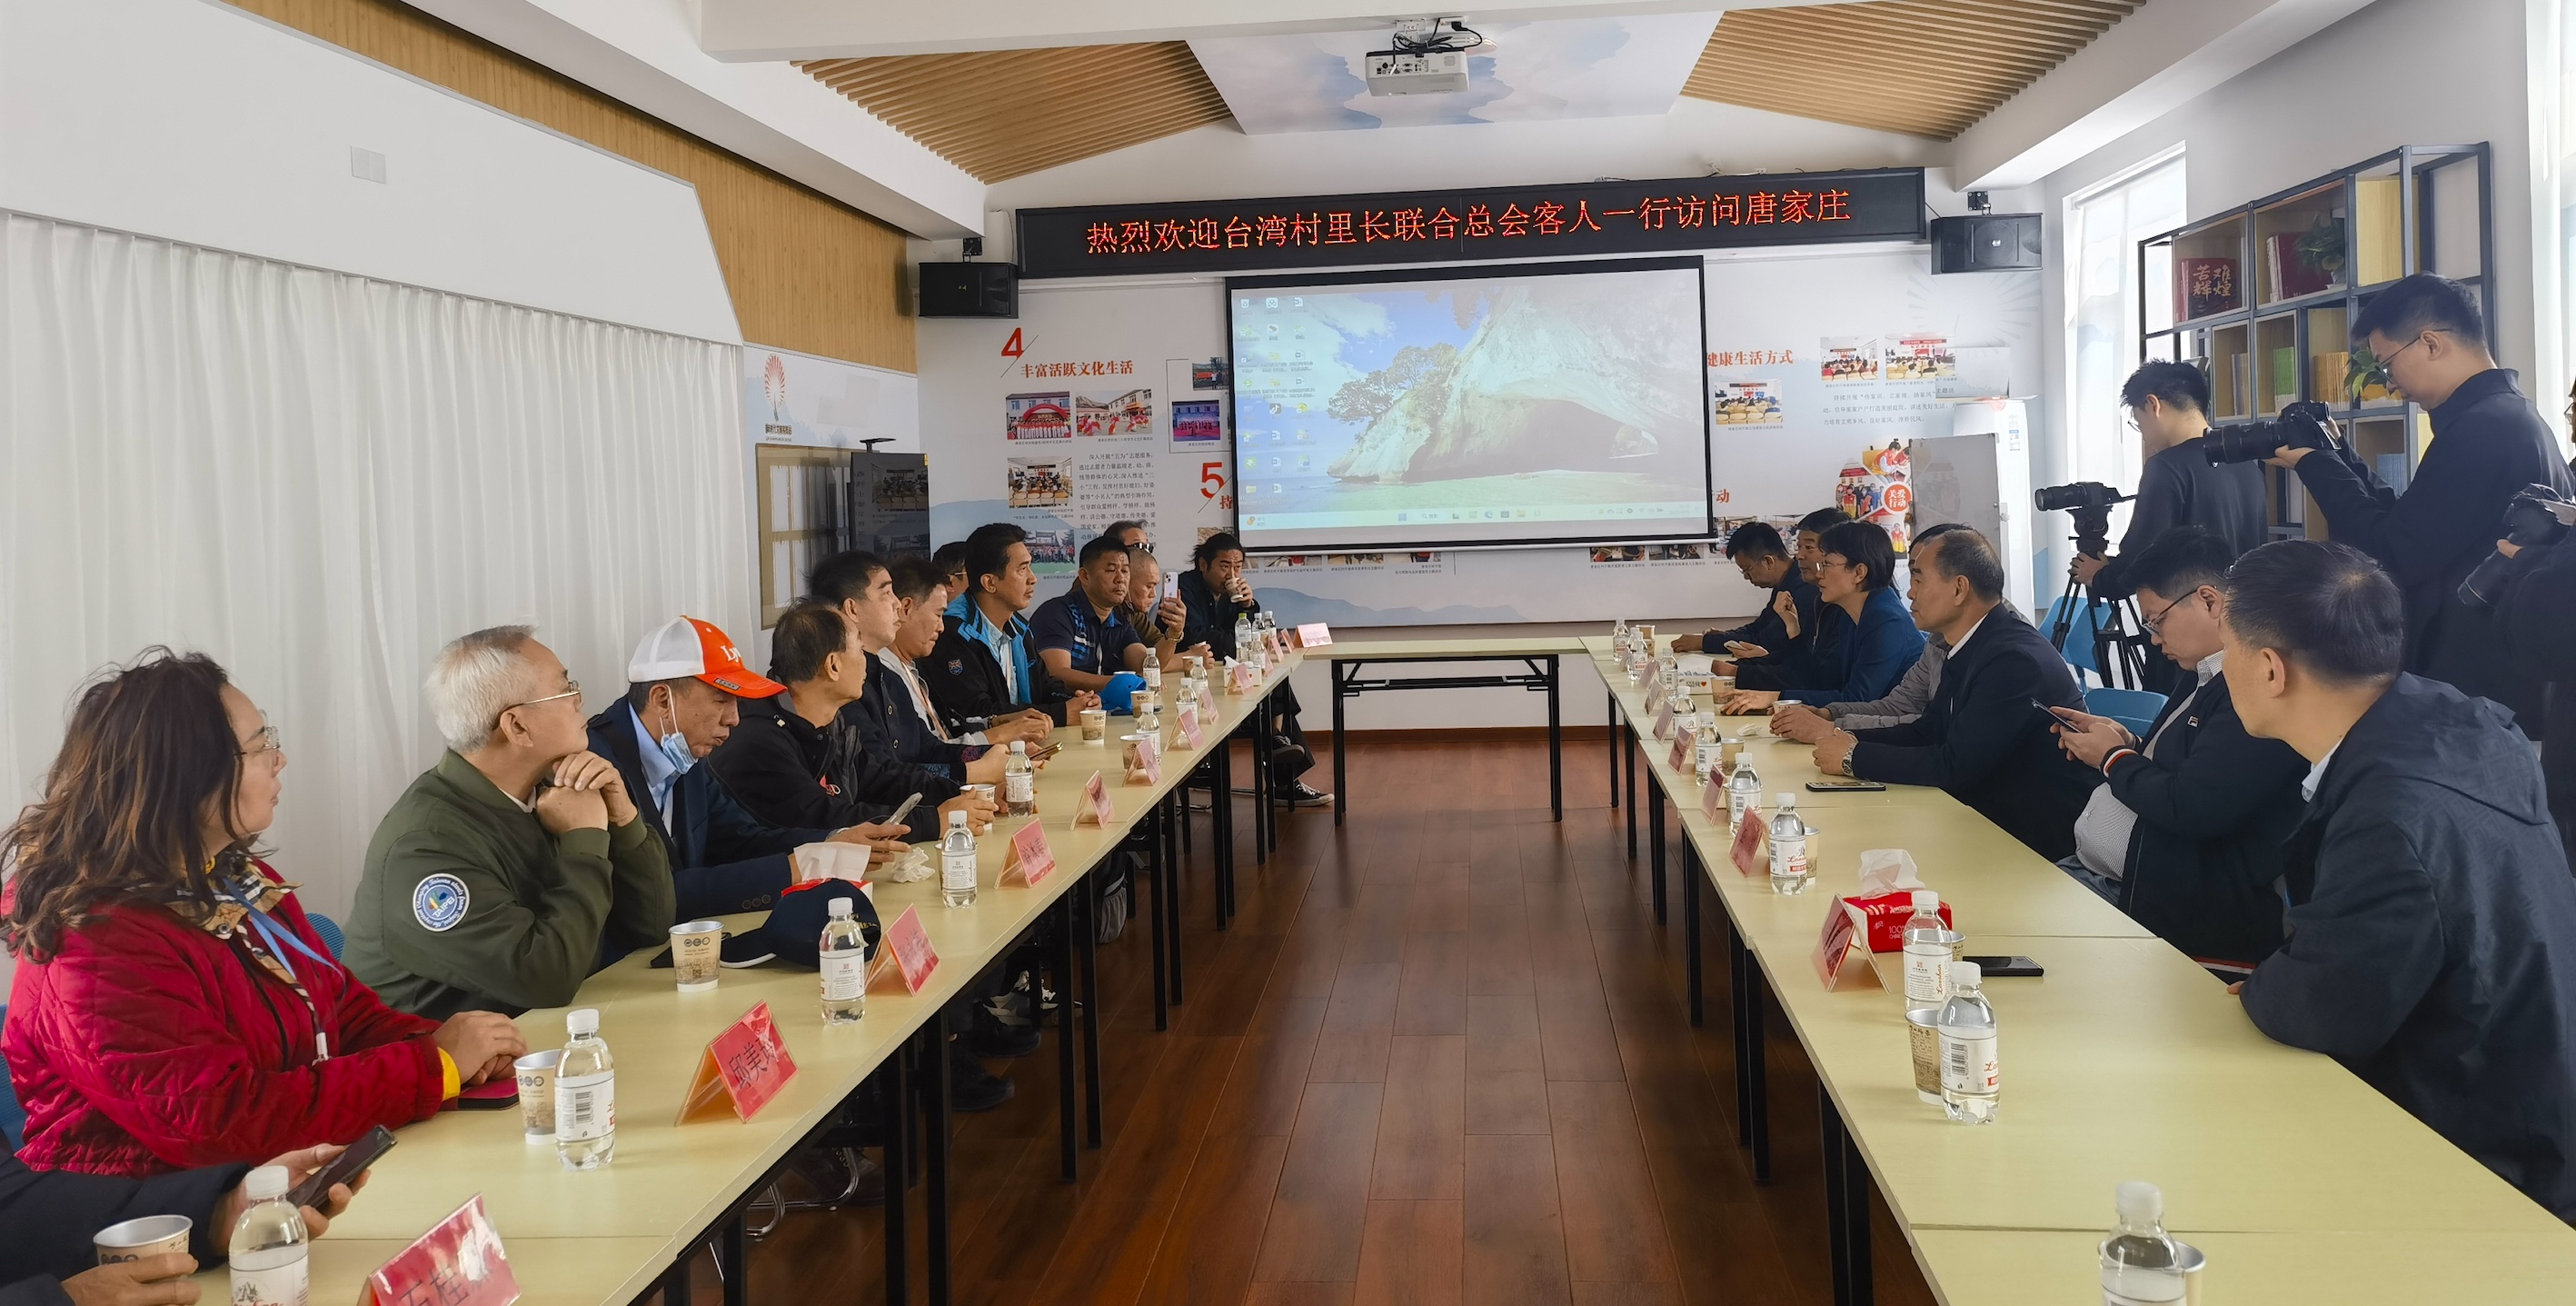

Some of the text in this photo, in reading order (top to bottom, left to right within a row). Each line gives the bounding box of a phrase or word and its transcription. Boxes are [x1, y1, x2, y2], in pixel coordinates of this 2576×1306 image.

[1087, 190, 1850, 254] 热烈欢迎台湾村里长联合总会客人一行访问唐家庄
[2193, 264, 2232, 283] 苦难
[1001, 327, 1024, 359] 4
[1707, 349, 1794, 367] 健康生活方式
[1020, 360, 1134, 378] 丰富活跃文化生活
[1200, 462, 1225, 500] 5
[1889, 489, 1906, 499] 关爱
[1889, 498, 1906, 508] 行动
